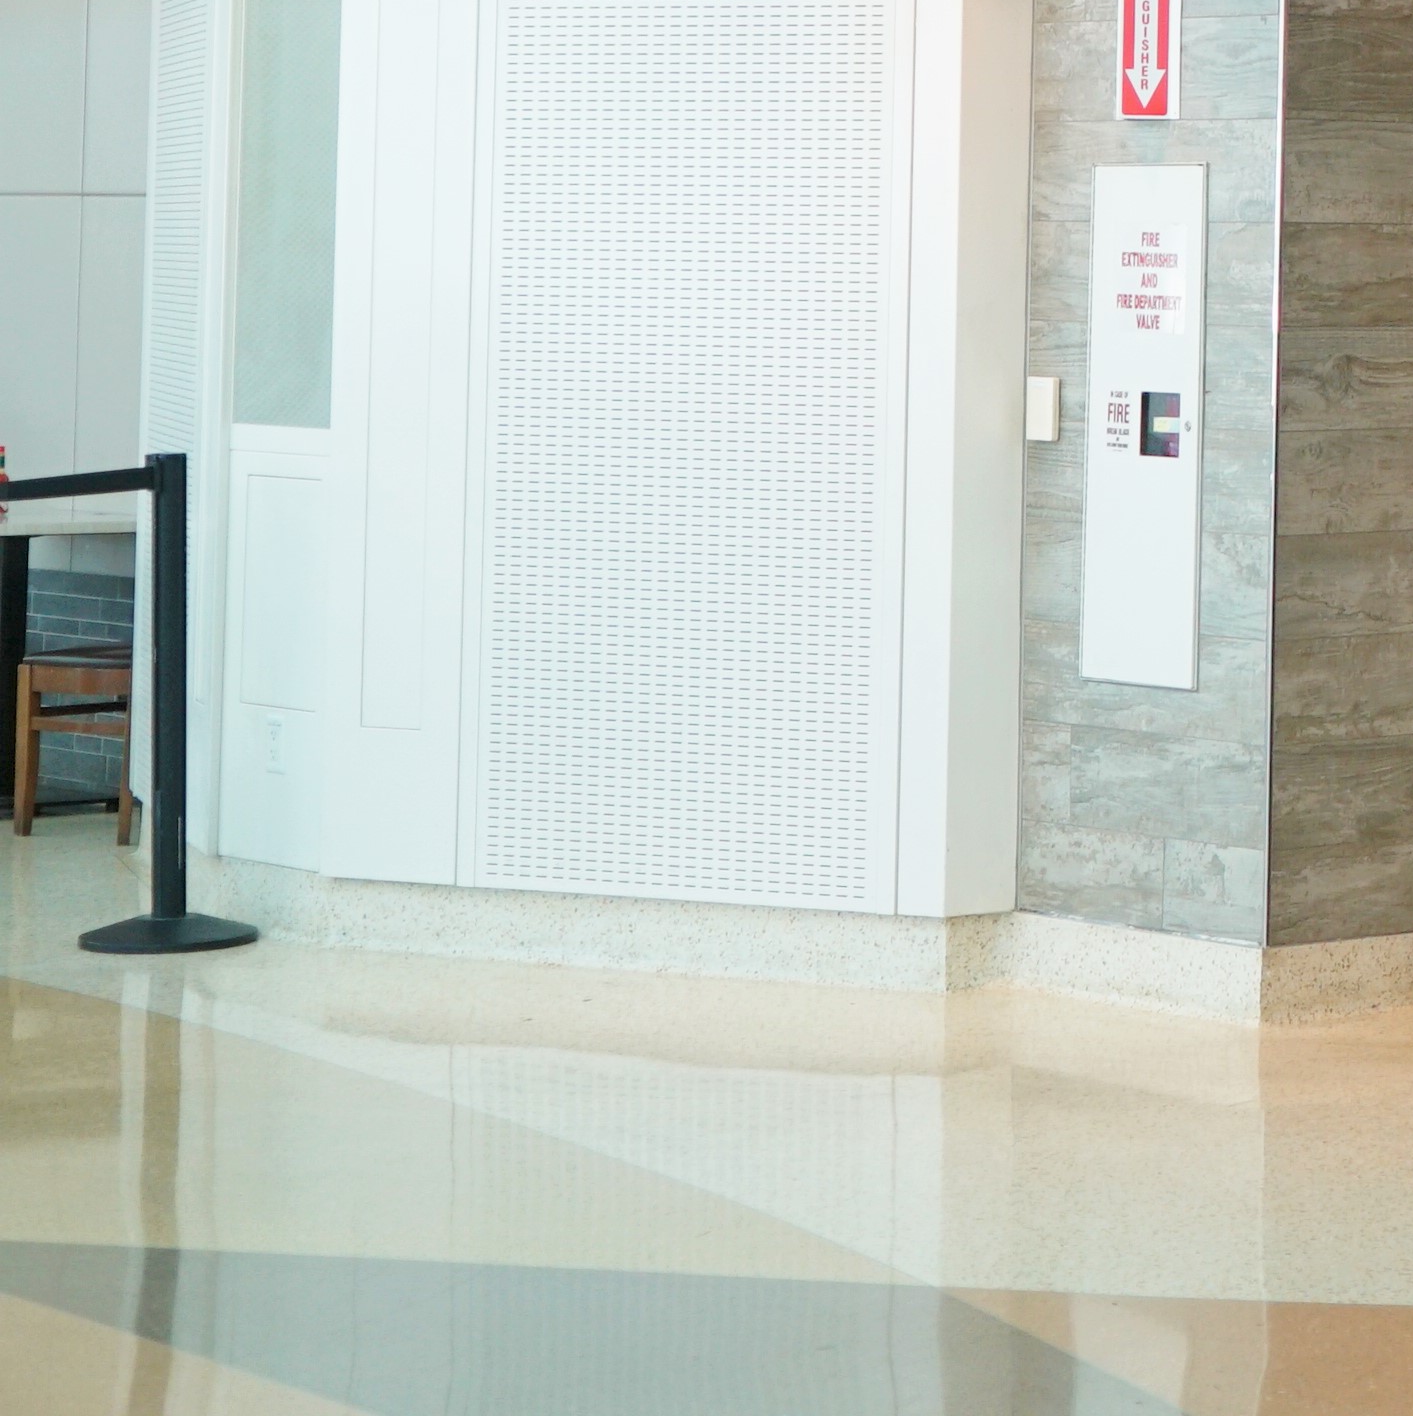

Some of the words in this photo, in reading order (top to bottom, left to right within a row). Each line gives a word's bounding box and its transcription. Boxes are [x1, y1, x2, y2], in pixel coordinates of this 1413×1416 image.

[1141, 232, 1160, 247] FIRE
[1121, 251, 1178, 269] EXTINGUISHER
[1140, 273, 1158, 289] AND
[1116, 294, 1133, 309] FIRE
[1134, 294, 1182, 311] DEPARTMENT
[1136, 313, 1160, 330] VALVE
[1107, 402, 1130, 424] FIRE
